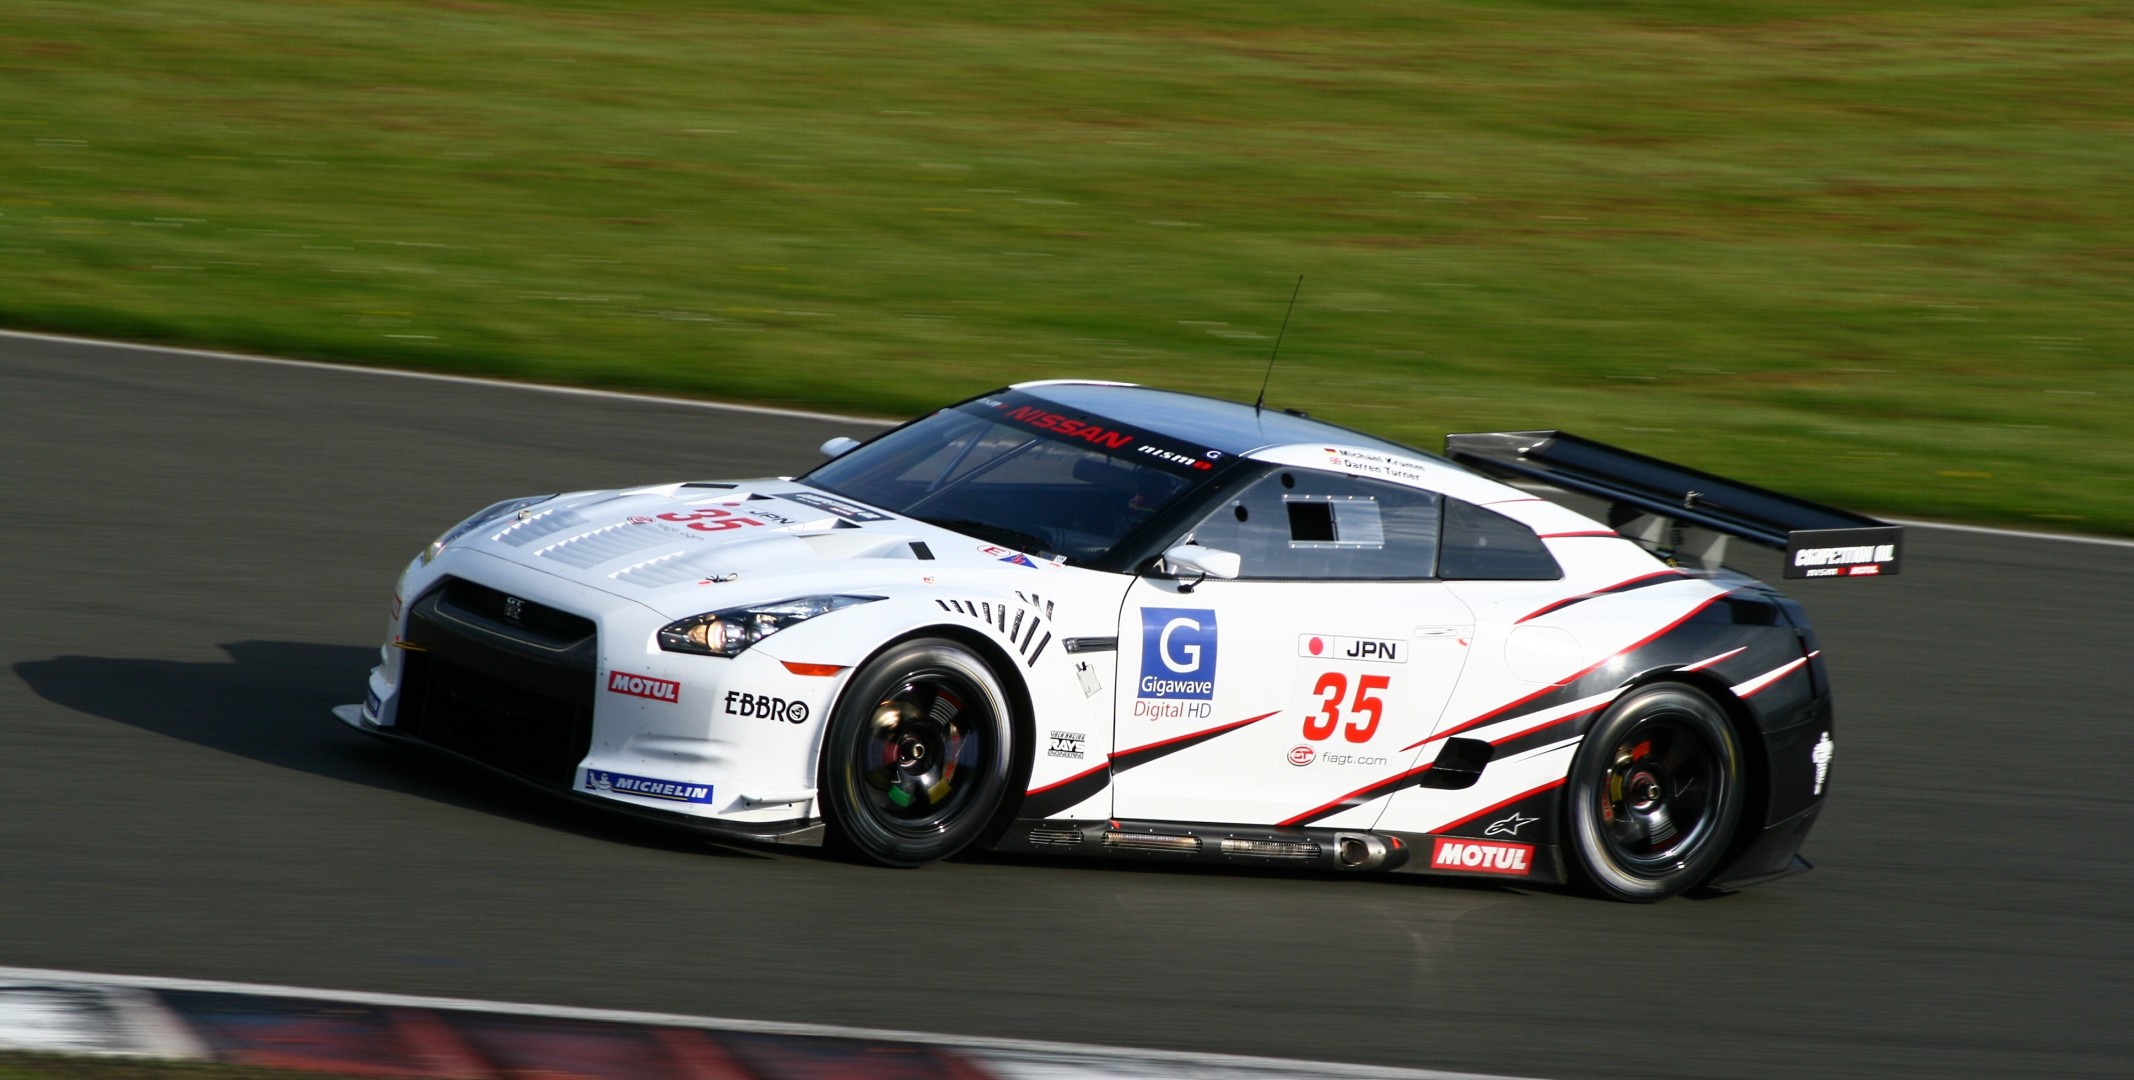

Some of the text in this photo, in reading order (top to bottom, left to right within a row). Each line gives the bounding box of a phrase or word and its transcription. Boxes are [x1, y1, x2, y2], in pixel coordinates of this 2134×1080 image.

[1004, 405, 1134, 449] NISSAN
[1138, 444, 1214, 471] nismo
[1344, 459, 1382, 474] Darren
[656, 508, 765, 531] 35
[749, 510, 795, 524] JPN
[1159, 617, 1201, 673] G
[1347, 640, 1396, 660] JPN
[611, 674, 677, 700] MOTUL
[1141, 675, 1212, 696] Gigawave
[724, 690, 809, 724] EBBRO
[1134, 700, 1212, 721] Digital HD
[1302, 671, 1391, 744] 35
[1050, 739, 1085, 752] RAYS
[1322, 751, 1387, 766] fiagt.com
[615, 777, 708, 799] MICHELIN
[1435, 842, 1527, 870] MOTUL
